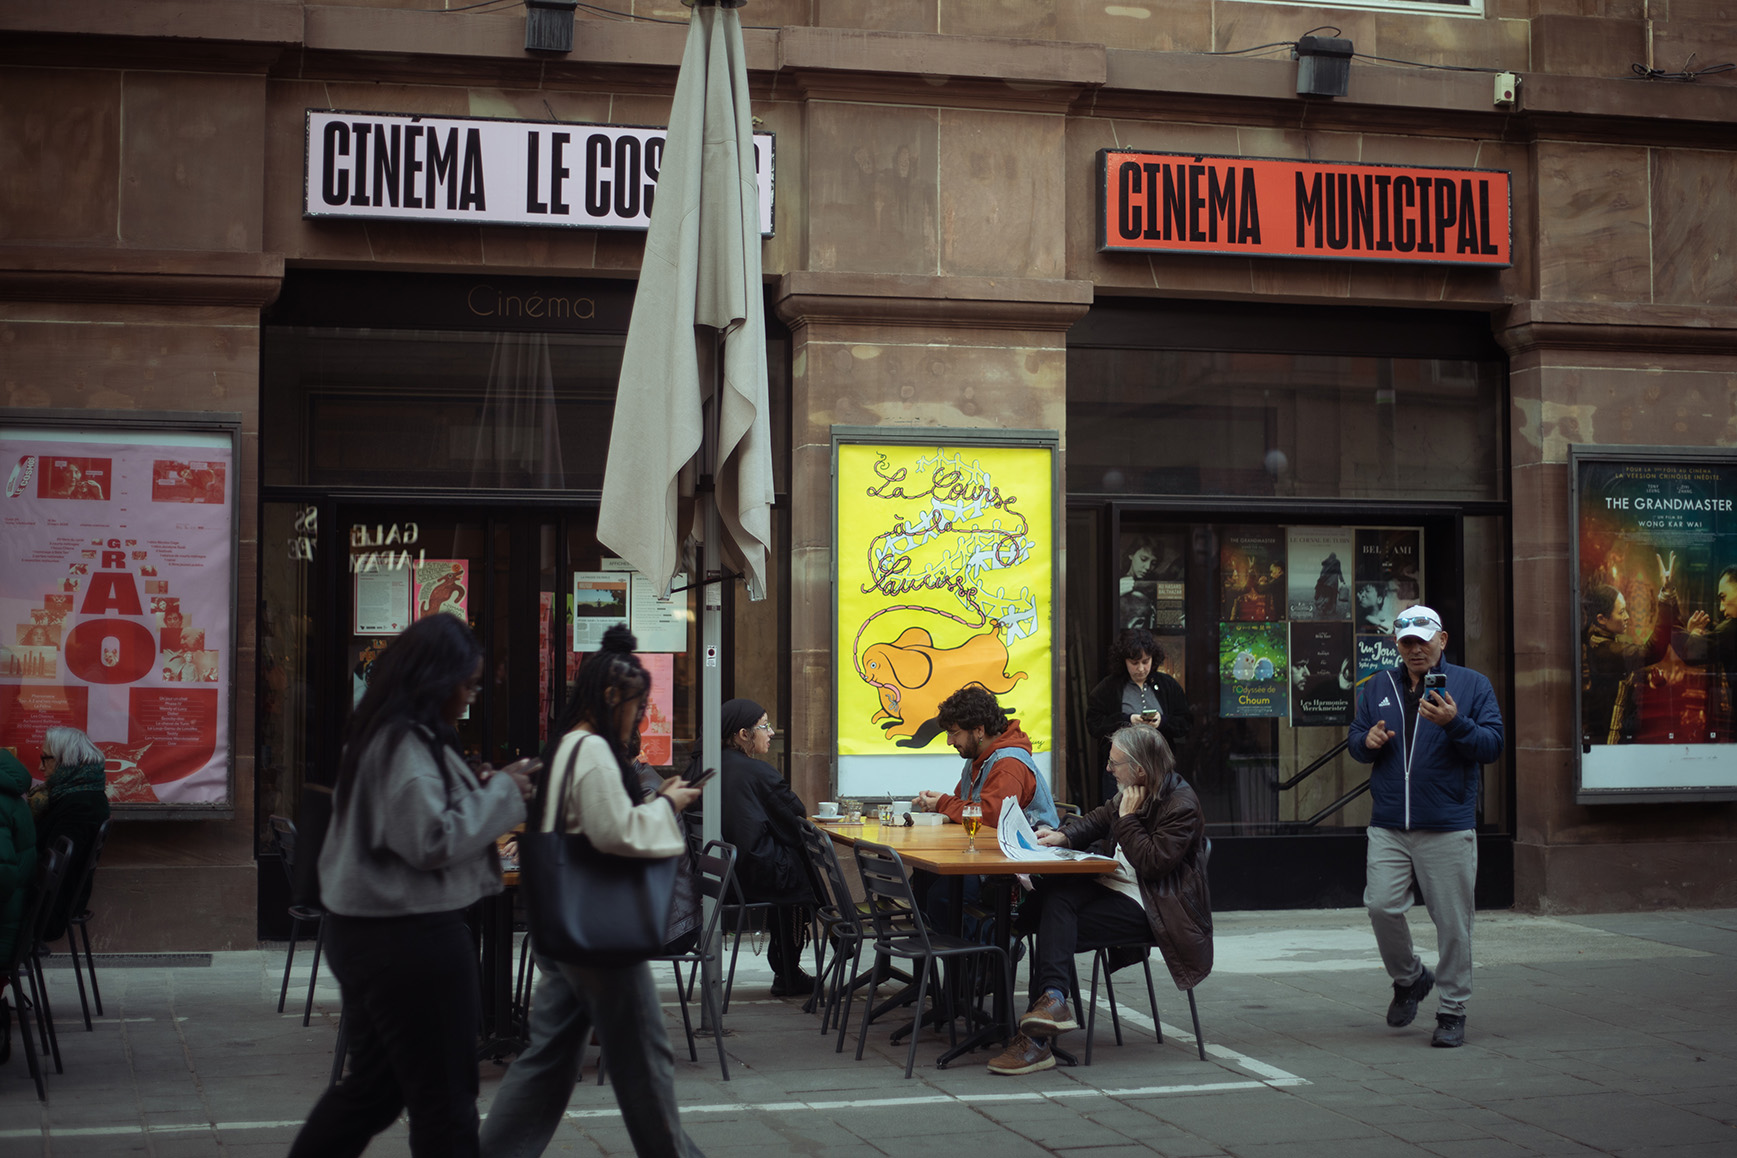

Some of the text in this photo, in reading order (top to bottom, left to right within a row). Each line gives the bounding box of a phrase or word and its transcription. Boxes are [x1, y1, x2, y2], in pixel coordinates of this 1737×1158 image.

[322, 117, 486, 212] CINÉMA
[526, 131, 571, 215] LE
[1118, 157, 1498, 256] CINÉMA MUNICIPAL
[467, 284, 595, 319] Cinéma
[867, 460, 1018, 509] La Course
[1605, 497, 1733, 511] THE GRANDMASTER
[1638, 520, 1665, 528] WONG
[1363, 545, 1412, 554] BEL AMI
[1238, 695, 1270, 705] Choum
